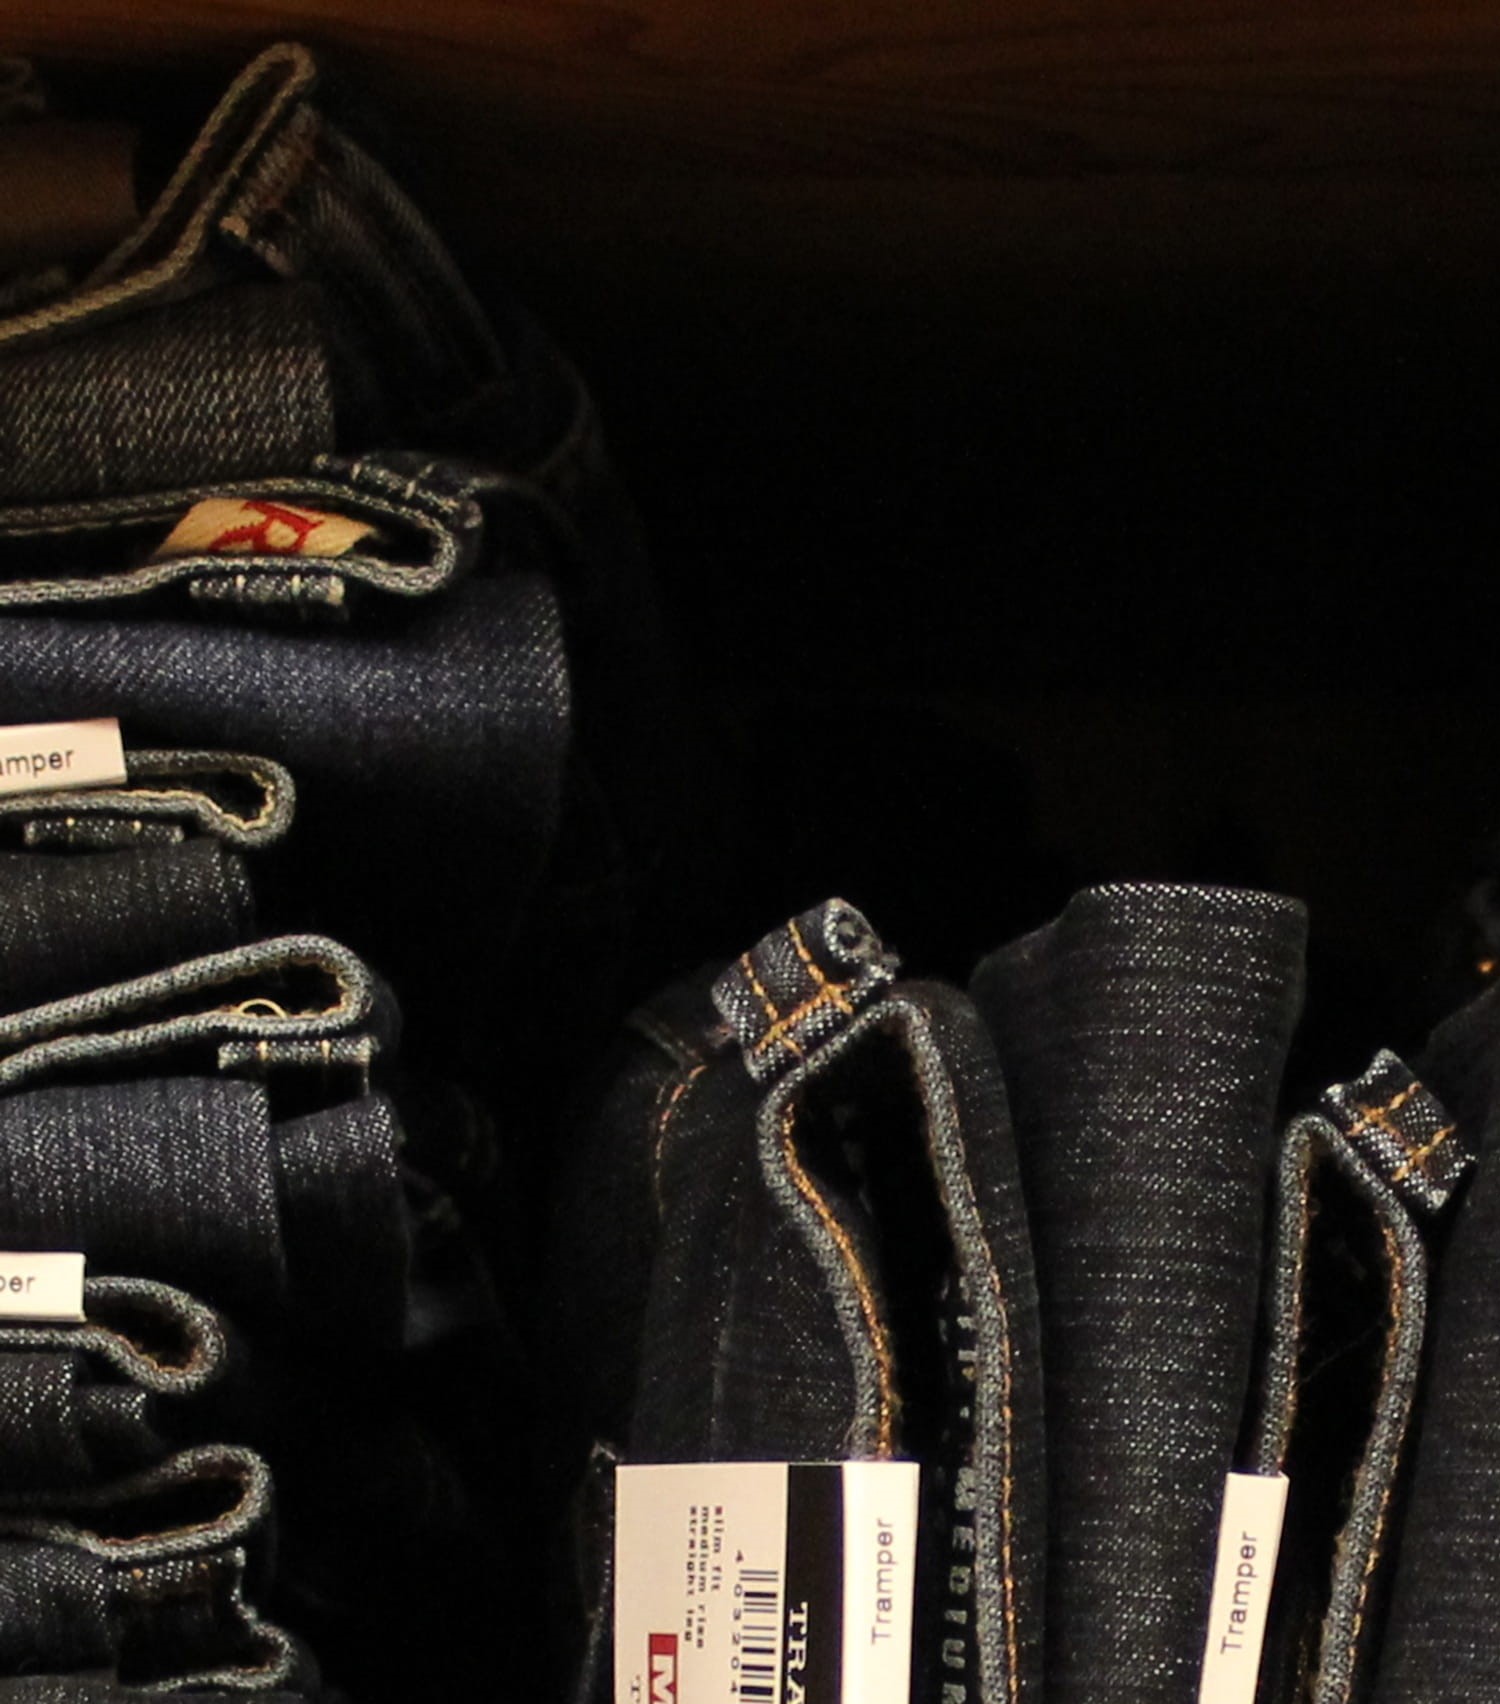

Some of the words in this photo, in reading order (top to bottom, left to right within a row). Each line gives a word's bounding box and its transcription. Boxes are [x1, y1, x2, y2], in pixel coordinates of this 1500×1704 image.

[0, 750, 74, 778] mper
[871, 1517, 898, 1645] Tramper
[1219, 1531, 1257, 1655] Tramper
